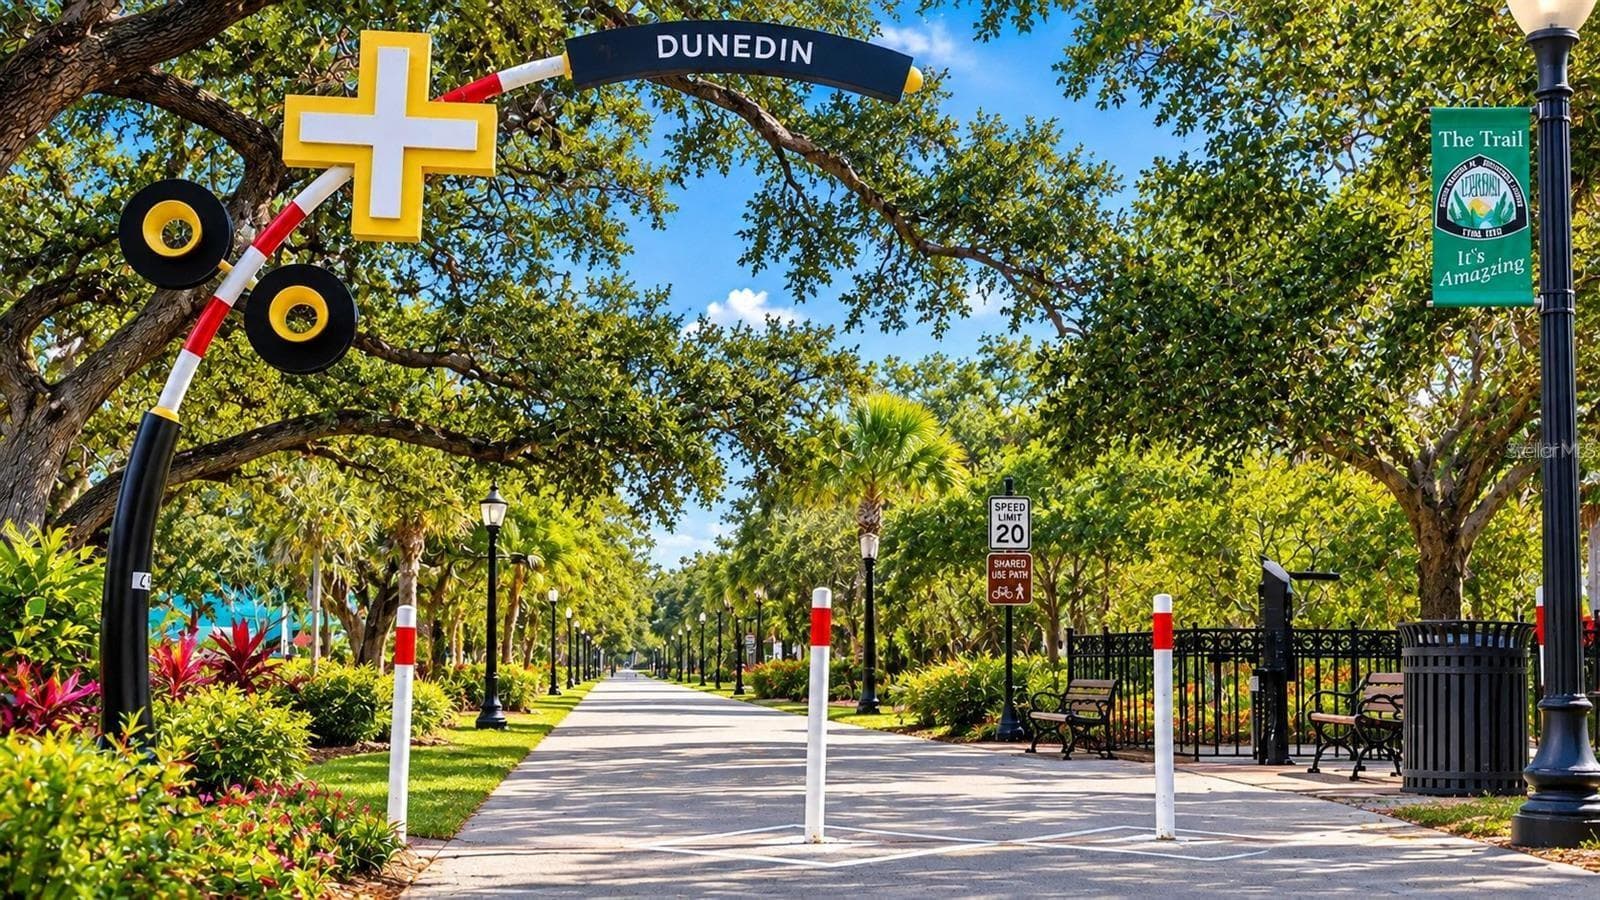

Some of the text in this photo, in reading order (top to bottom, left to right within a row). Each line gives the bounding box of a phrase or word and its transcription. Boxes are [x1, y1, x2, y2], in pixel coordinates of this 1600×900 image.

[656, 33, 814, 65] DUNEDIN
[1438, 130, 1524, 148] The Trail
[994, 502, 1026, 512] SPEED
[998, 513, 1022, 521] LIMIT
[996, 523, 1024, 543] 20
[993, 559, 1027, 568] SHARED
[991, 570, 1029, 579] USE PATH
